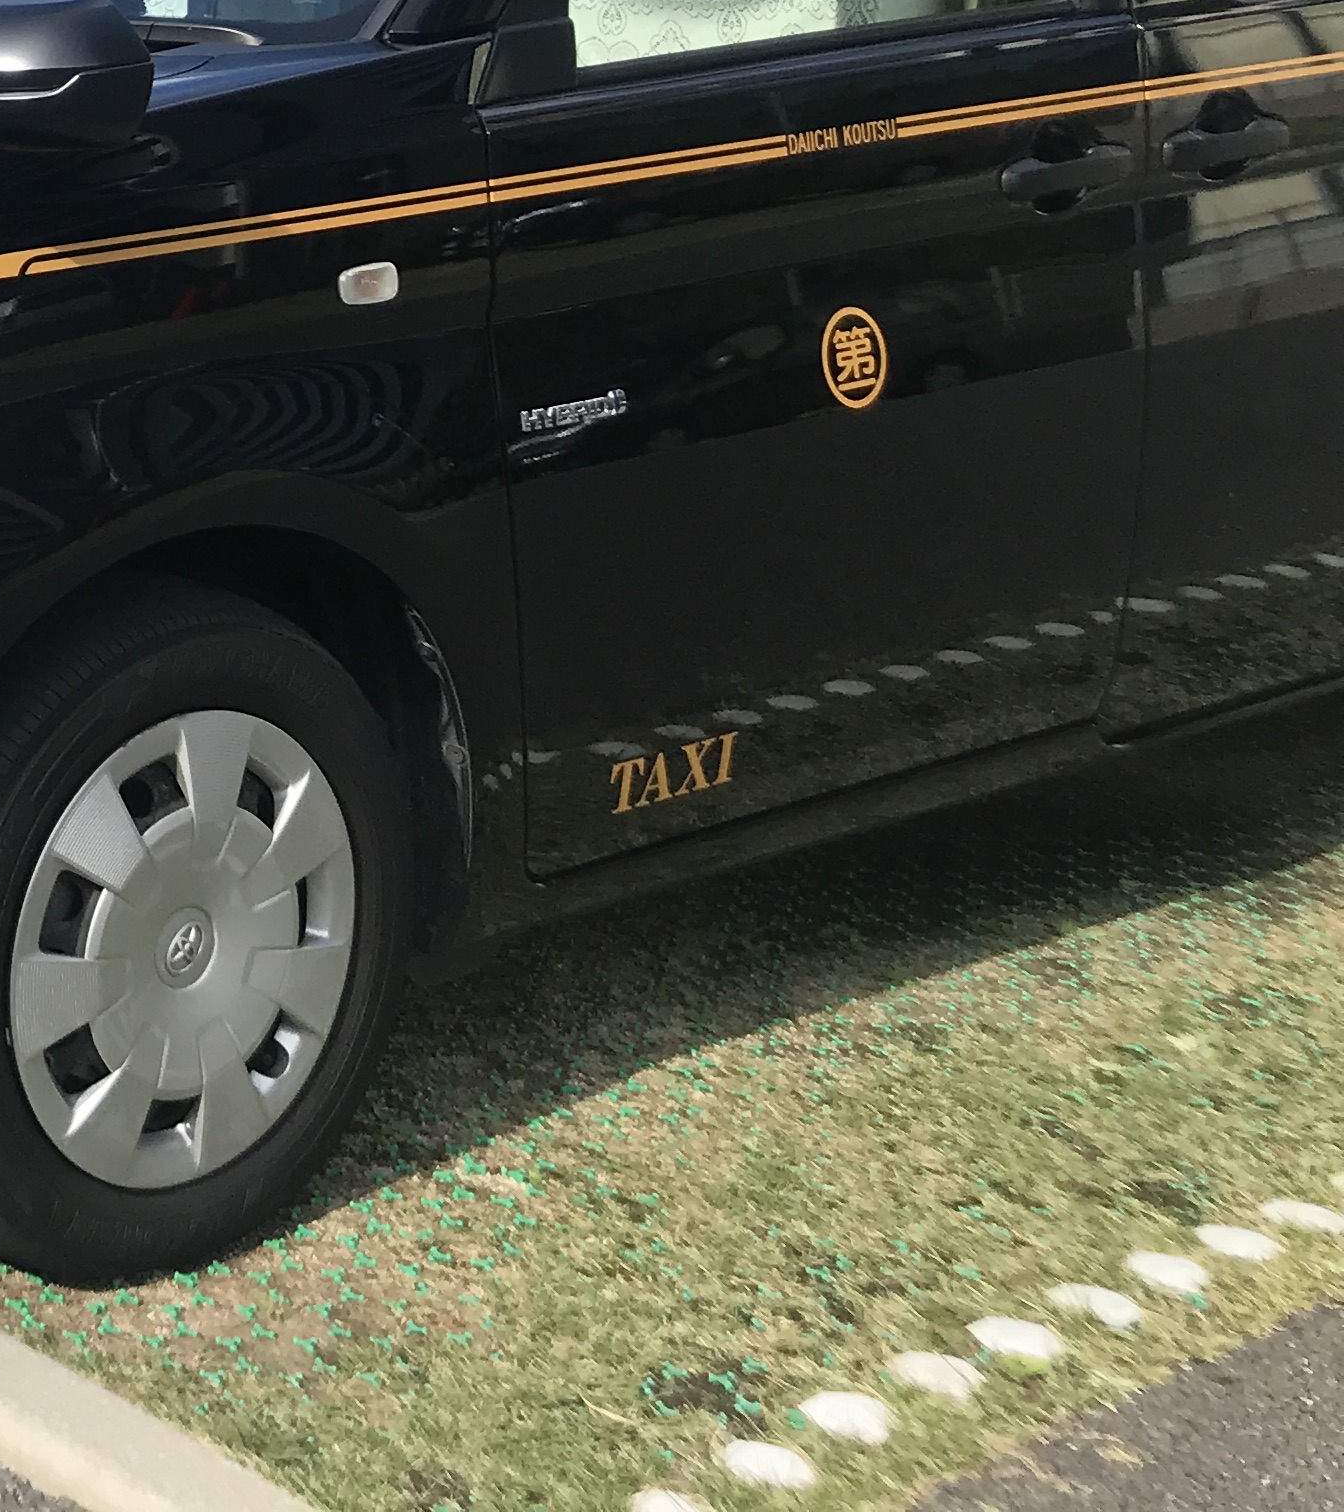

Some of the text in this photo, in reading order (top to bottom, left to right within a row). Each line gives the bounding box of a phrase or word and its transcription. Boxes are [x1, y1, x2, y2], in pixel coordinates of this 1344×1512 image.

[788, 118, 896, 155] DAIICHI KOUTSU
[833, 325, 877, 392] 第一
[610, 731, 739, 815] TAXI
